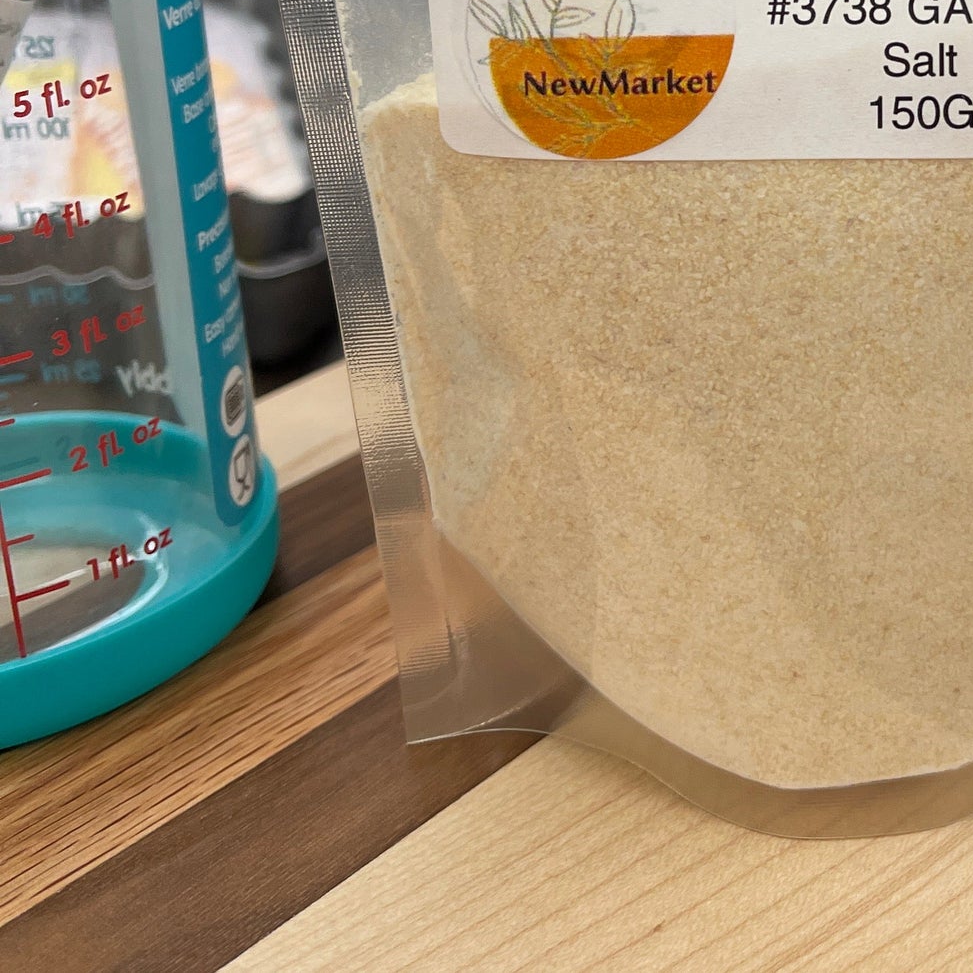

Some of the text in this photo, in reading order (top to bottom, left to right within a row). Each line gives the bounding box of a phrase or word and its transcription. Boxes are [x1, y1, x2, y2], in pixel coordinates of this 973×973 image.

[523, 68, 718, 96] NewMarket
[883, 41, 958, 78] Salt
[13, 73, 112, 118] 5 fl. oz
[32, 213, 54, 238] 4
[62, 201, 90, 238] fl.
[99, 191, 131, 218] oz
[51, 304, 147, 357] 3 fl. oz
[69, 417, 162, 472] 2 fl. oz
[86, 527, 173, 581] 1 fl. oz
